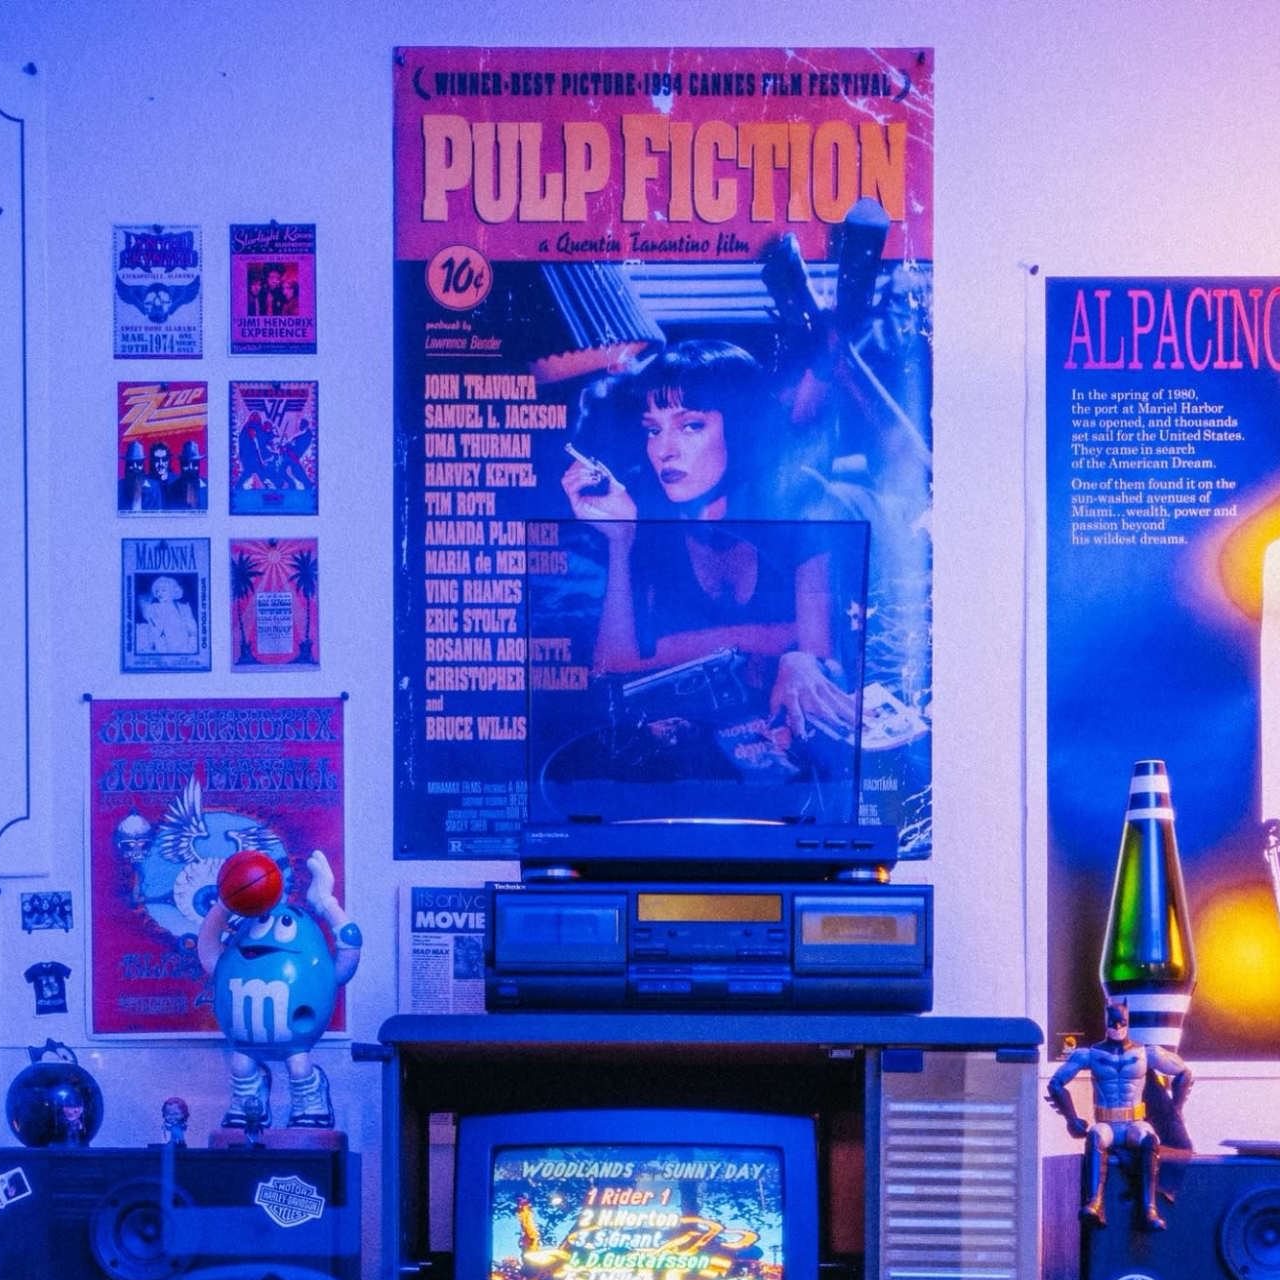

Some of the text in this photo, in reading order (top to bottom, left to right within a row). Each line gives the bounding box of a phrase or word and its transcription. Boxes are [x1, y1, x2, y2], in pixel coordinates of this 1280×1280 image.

[688, 73, 756, 97] CANNES
[762, 73, 803, 97] FILM
[808, 73, 892, 97] FESTIVAL
[423, 112, 908, 224] PULP FICTION
[538, 232, 750, 257] a Quentin Tarantino film
[237, 317, 314, 328] JIMI HENDRIX
[241, 327, 309, 338] EXPERIENCE
[424, 374, 537, 400] JOHN TRAVOLTA
[1072, 389, 1199, 402] In the spring of 1980,
[424, 404, 567, 430] SAMUEL L. JACKSON
[1072, 402, 1224, 417] the port Mariel Harbor
[1147, 416, 1238, 427] and thousands
[424, 433, 531, 458] UMA THURMAN
[1159, 429, 1245, 441] United States.
[424, 462, 537, 487] HARVEY KEITEL
[1108, 457, 1217, 469] American Dream.
[424, 492, 496, 516] TIM ROTH
[424, 521, 485, 546] AMANDA
[135, 543, 197, 570] MADONNA
[425, 550, 469, 574] MARIA
[475, 551, 491, 574] de
[425, 579, 523, 604] VING RHAMES
[425, 608, 517, 633] ERIC STOLTZ
[425, 638, 493, 661] ROSANNA
[425, 667, 589, 691] CHRISTOPHER WALKEN
[425, 694, 444, 712] and
[425, 716, 527, 741] BRUCE WILLIS
[415, 911, 485, 929] MOVIE
[229, 977, 293, 1043] m
[522, 1161, 765, 1180] WOODLANDS SUNNY DAY
[587, 1189, 597, 1205] 1
[600, 1188, 654, 1206] Rider
